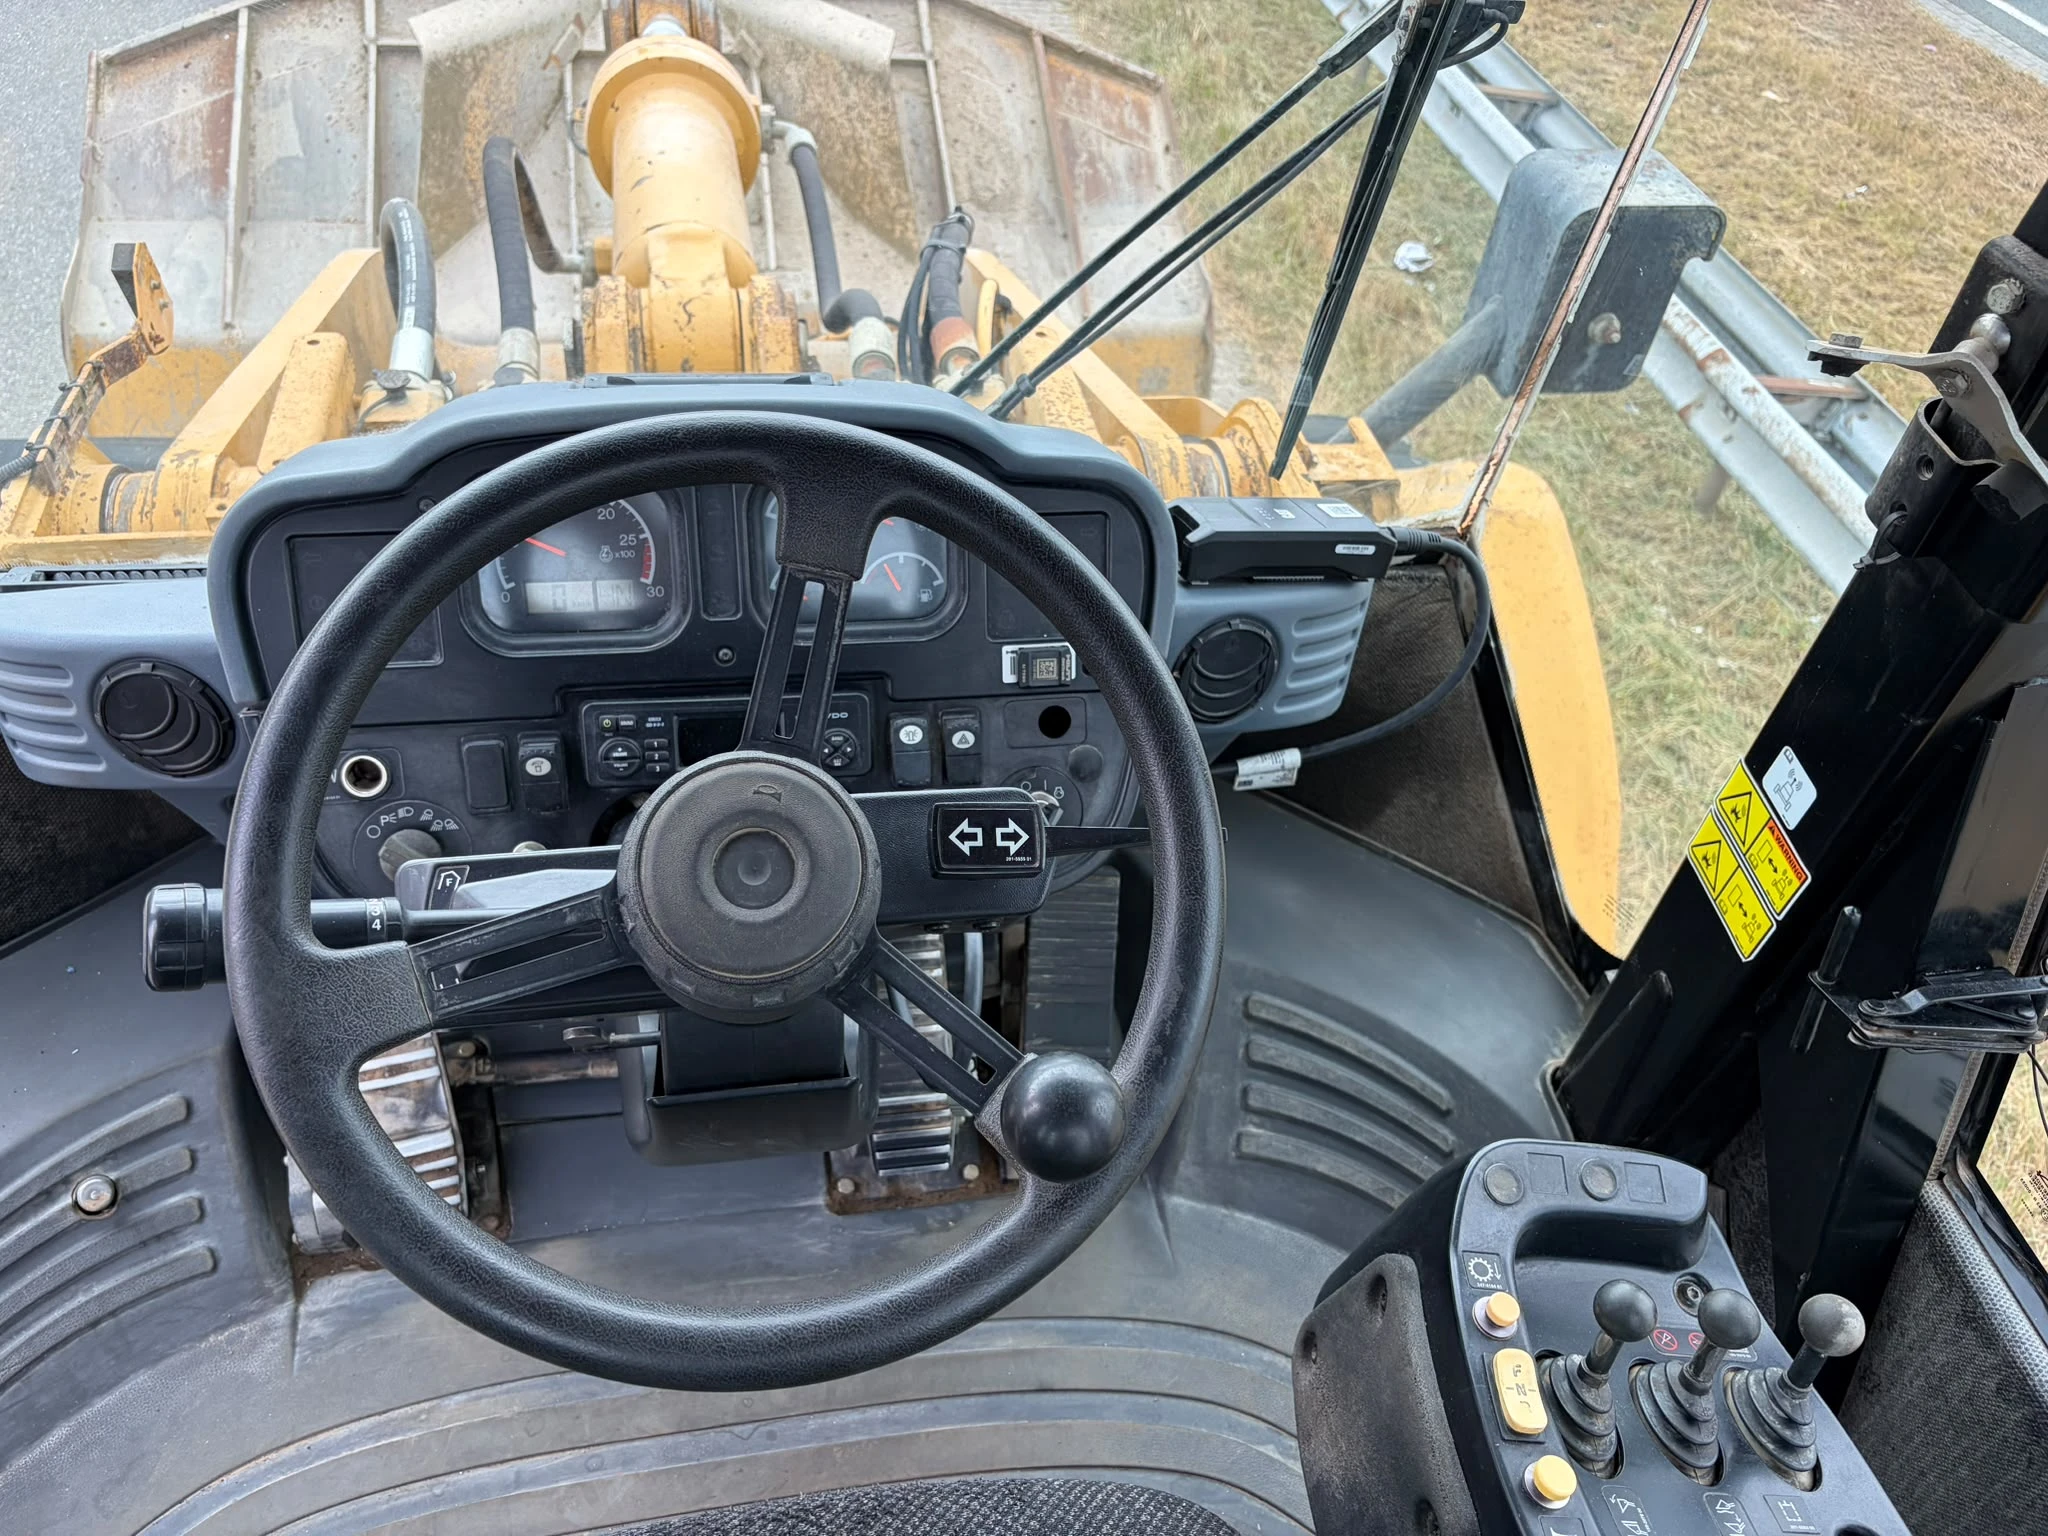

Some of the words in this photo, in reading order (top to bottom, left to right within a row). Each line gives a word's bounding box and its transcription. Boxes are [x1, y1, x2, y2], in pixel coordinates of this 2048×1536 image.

[597, 507, 616, 520] 20
[619, 534, 637, 546] 25
[615, 550, 636, 559] x100
[501, 591, 511, 603] 0
[646, 585, 665, 598] 30
[1775, 833, 1804, 881] WARNING
[446, 878, 453, 887] F
[371, 906, 381, 917] 3
[371, 918, 382, 931] 4
[1515, 1383, 1527, 1396] N
